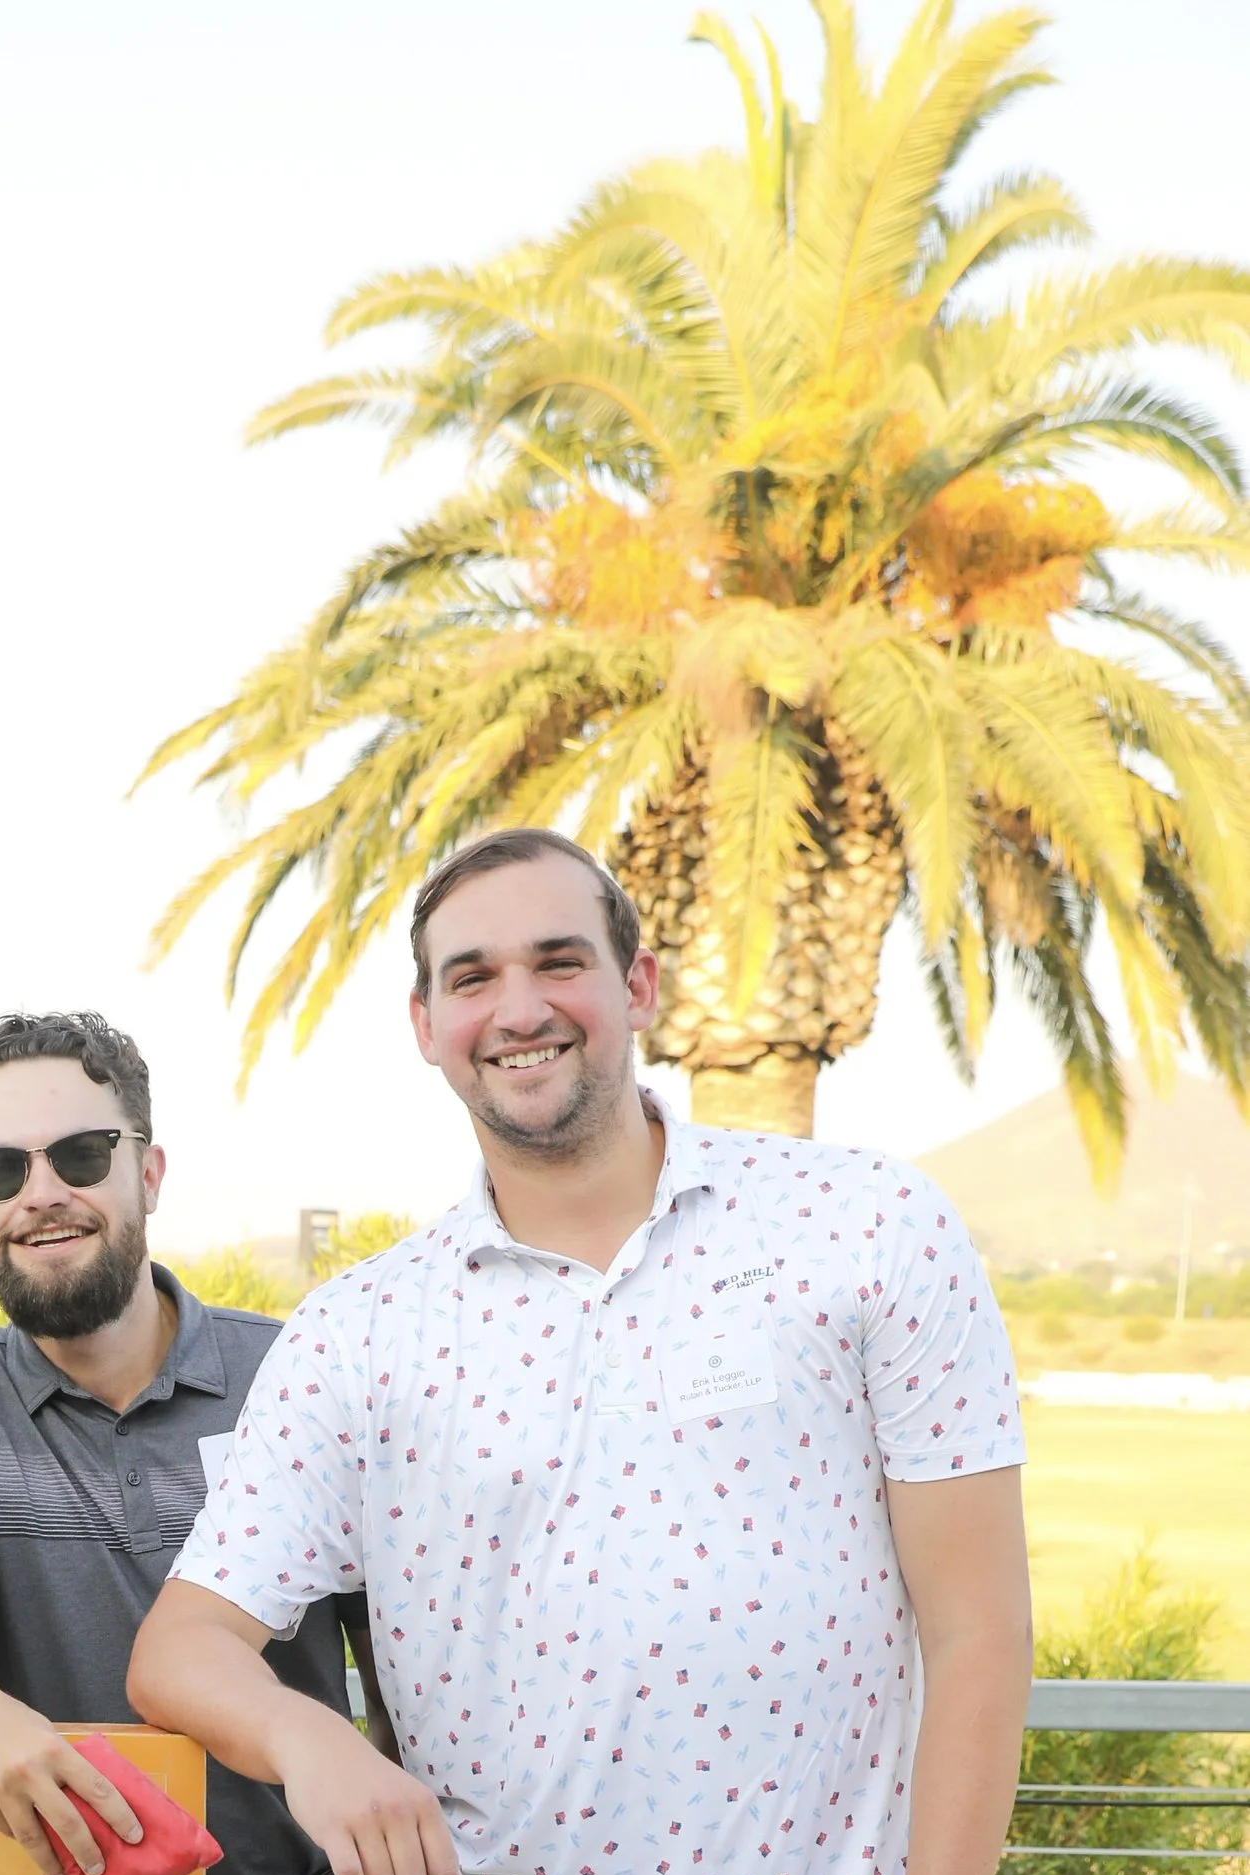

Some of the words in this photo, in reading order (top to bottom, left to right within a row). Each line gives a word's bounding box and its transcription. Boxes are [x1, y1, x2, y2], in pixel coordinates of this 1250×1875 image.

[712, 1275, 738, 1294] RED
[743, 1266, 774, 1279] HILL
[680, 1391, 703, 1402] Rutan
[705, 1388, 711, 1396] &
[714, 1382, 744, 1393] Tucker,
[746, 1377, 762, 1387] LLP
[692, 1378, 710, 1388] Erik
[713, 1370, 745, 1383] Leggio
